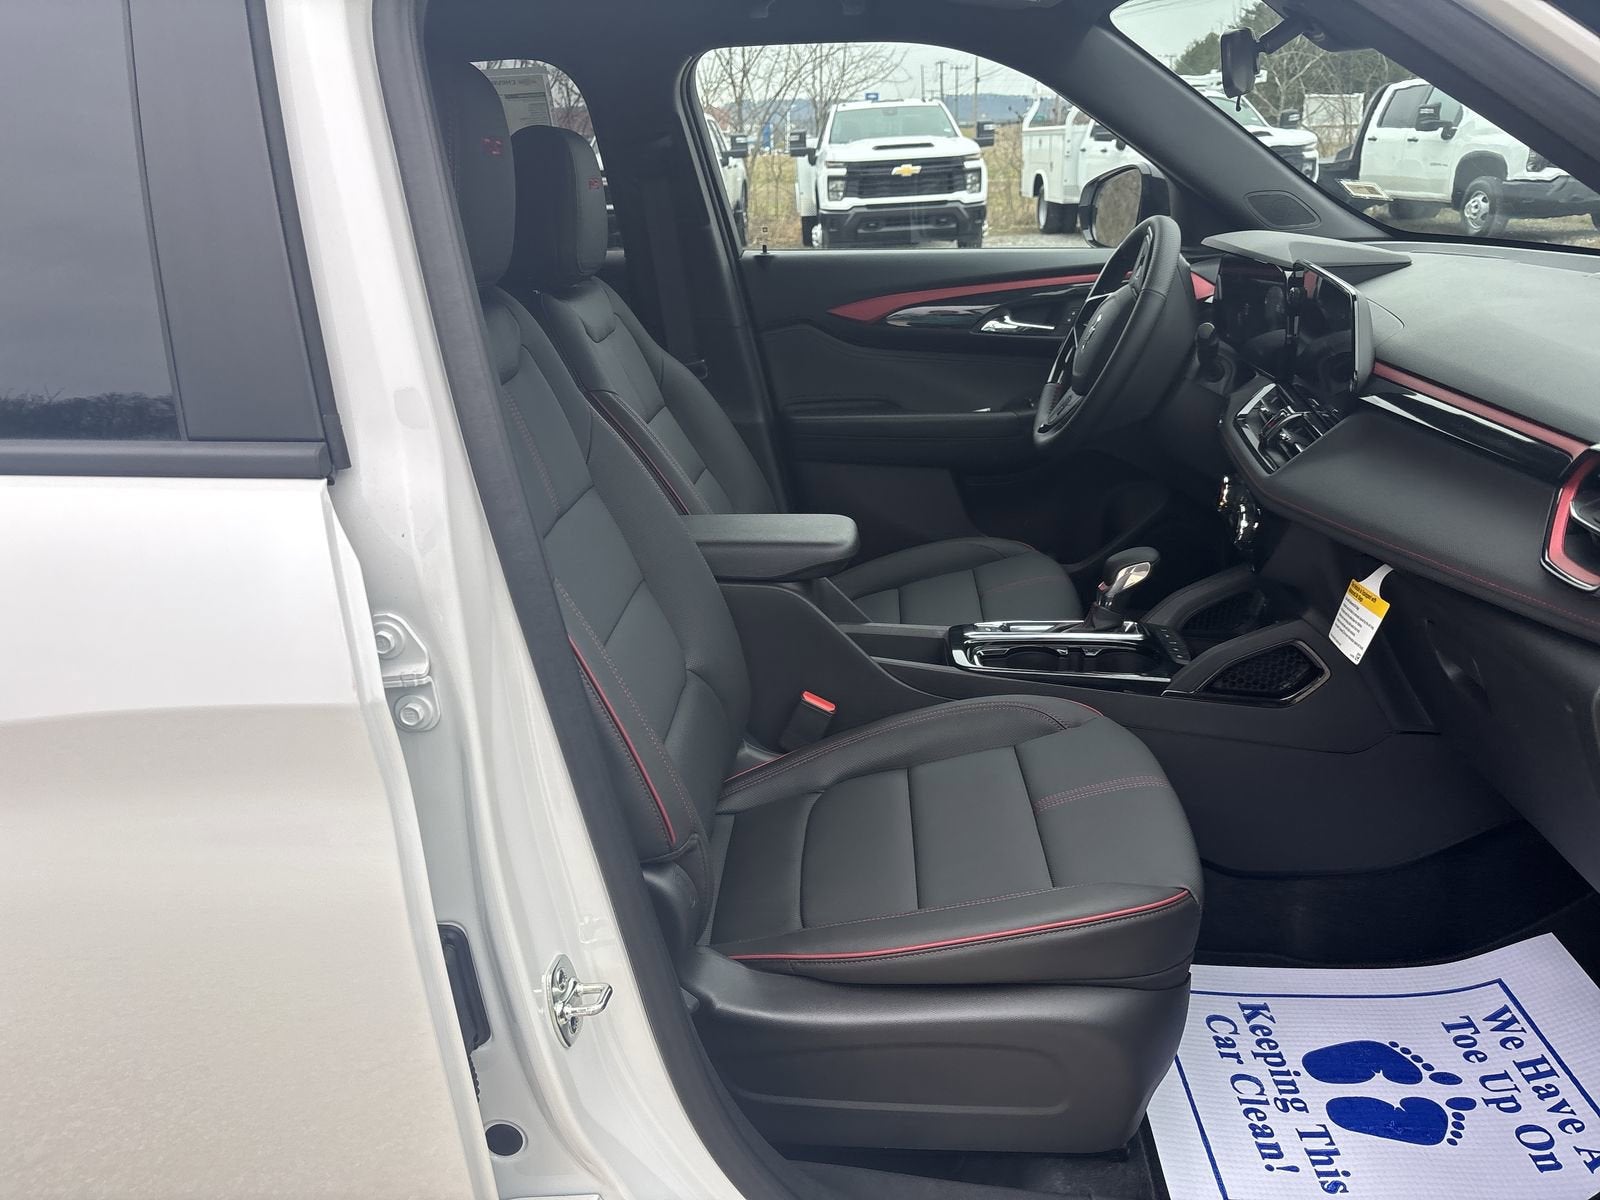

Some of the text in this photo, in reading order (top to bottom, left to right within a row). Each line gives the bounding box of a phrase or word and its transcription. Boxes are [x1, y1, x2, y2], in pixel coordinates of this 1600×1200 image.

[1205, 1014, 1300, 1173] Car Clean!
[1237, 1001, 1351, 1195] Keeping This
[1441, 1015, 1564, 1174] Toe Up On
[1482, 1004, 1527, 1051] We
[1513, 1054, 1586, 1135] Have
